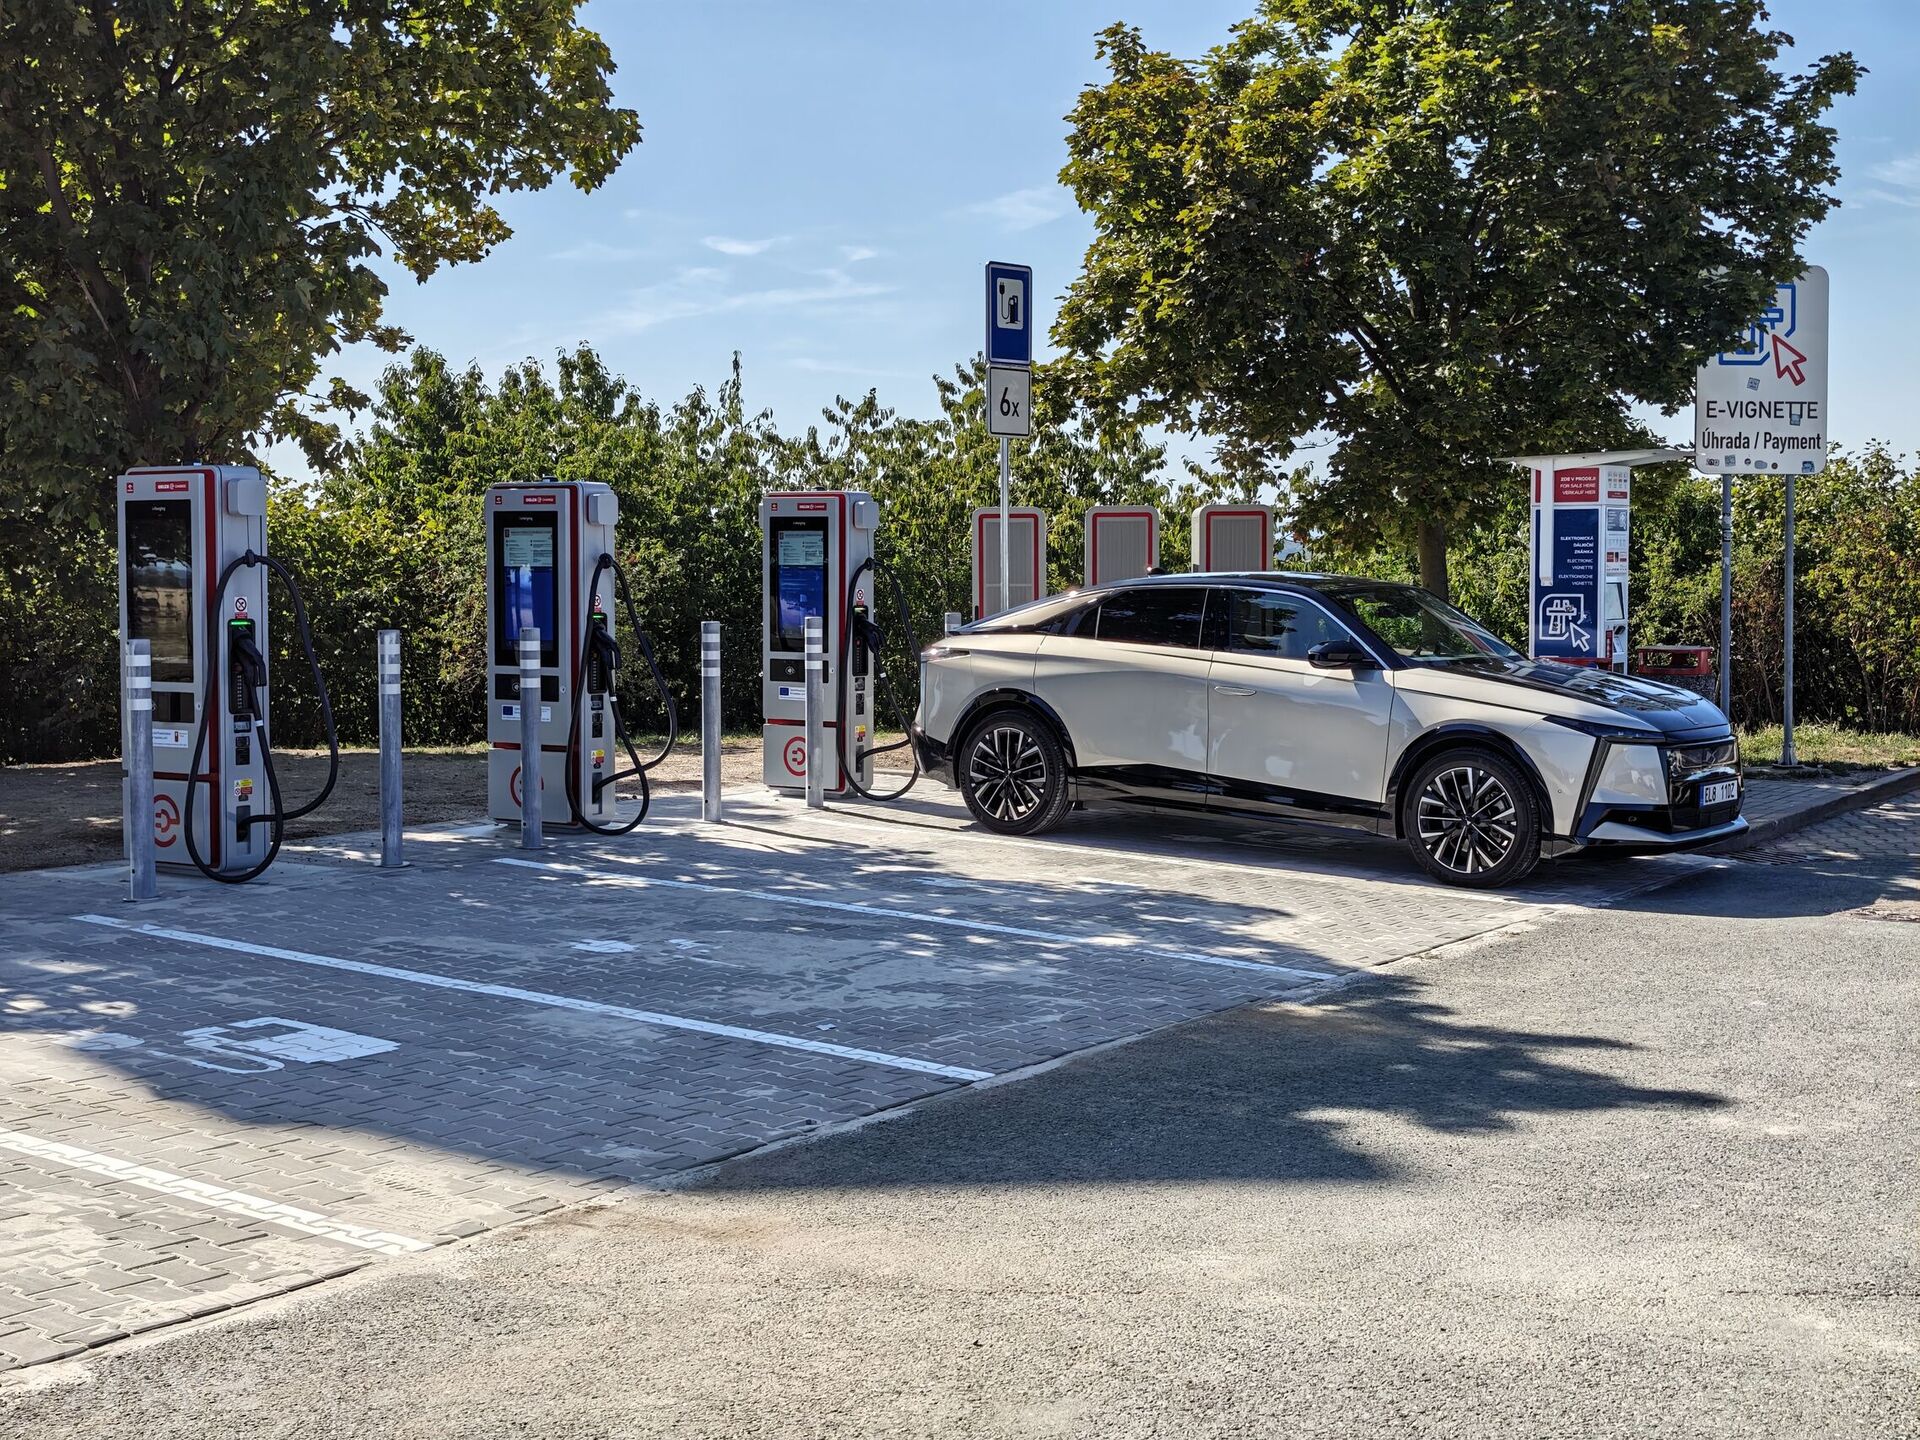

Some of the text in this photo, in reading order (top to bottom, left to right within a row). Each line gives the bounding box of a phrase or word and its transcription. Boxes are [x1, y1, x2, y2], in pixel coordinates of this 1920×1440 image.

[1000, 386, 1020, 417] 6x
[1706, 400, 1818, 419] E-VIGNETTE
[1702, 427, 1822, 454] Úhrada / Payment
